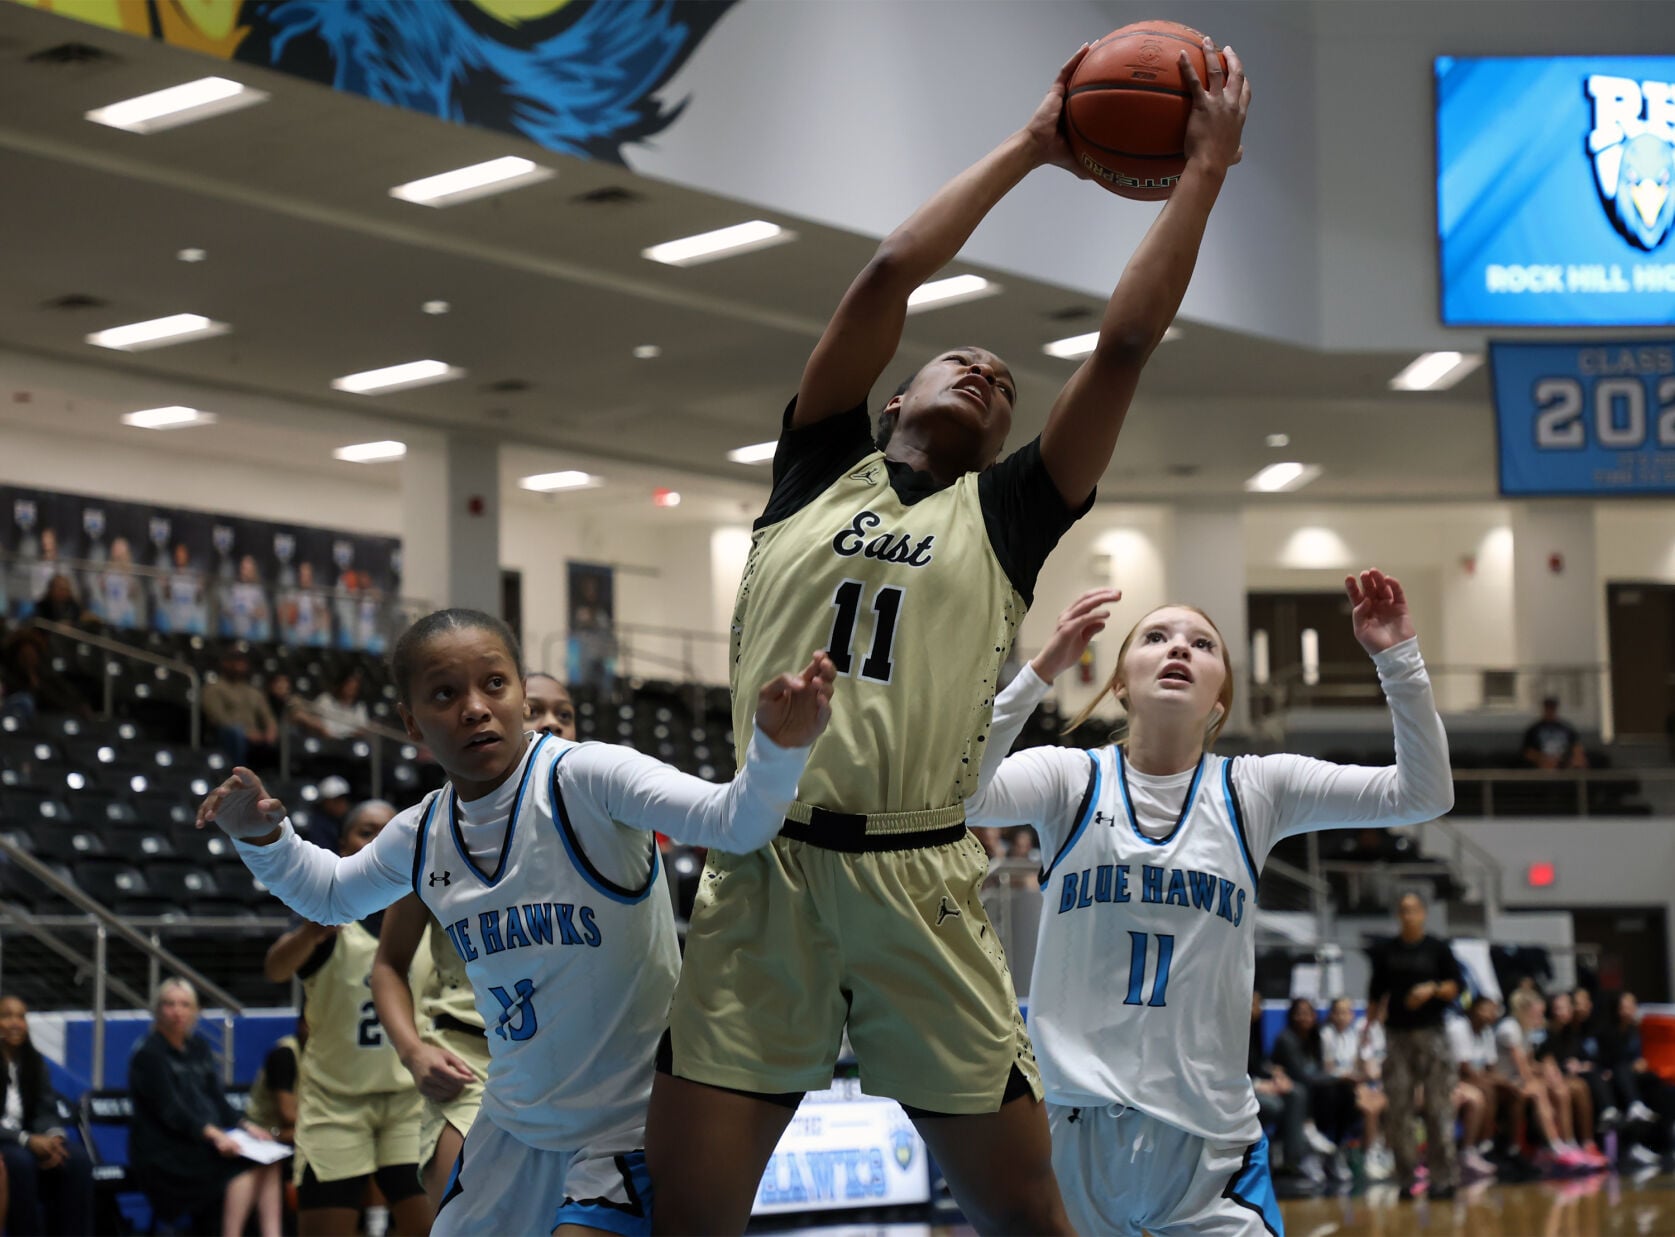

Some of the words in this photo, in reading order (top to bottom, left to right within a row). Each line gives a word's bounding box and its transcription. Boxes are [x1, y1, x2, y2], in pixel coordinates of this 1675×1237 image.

[833, 510, 935, 569] East
[826, 577, 906, 686] 11
[1058, 864, 1131, 914] BLUE
[1141, 864, 1246, 928] HAWKS
[478, 902, 602, 955] HAWKS
[1122, 930, 1175, 1007] 11
